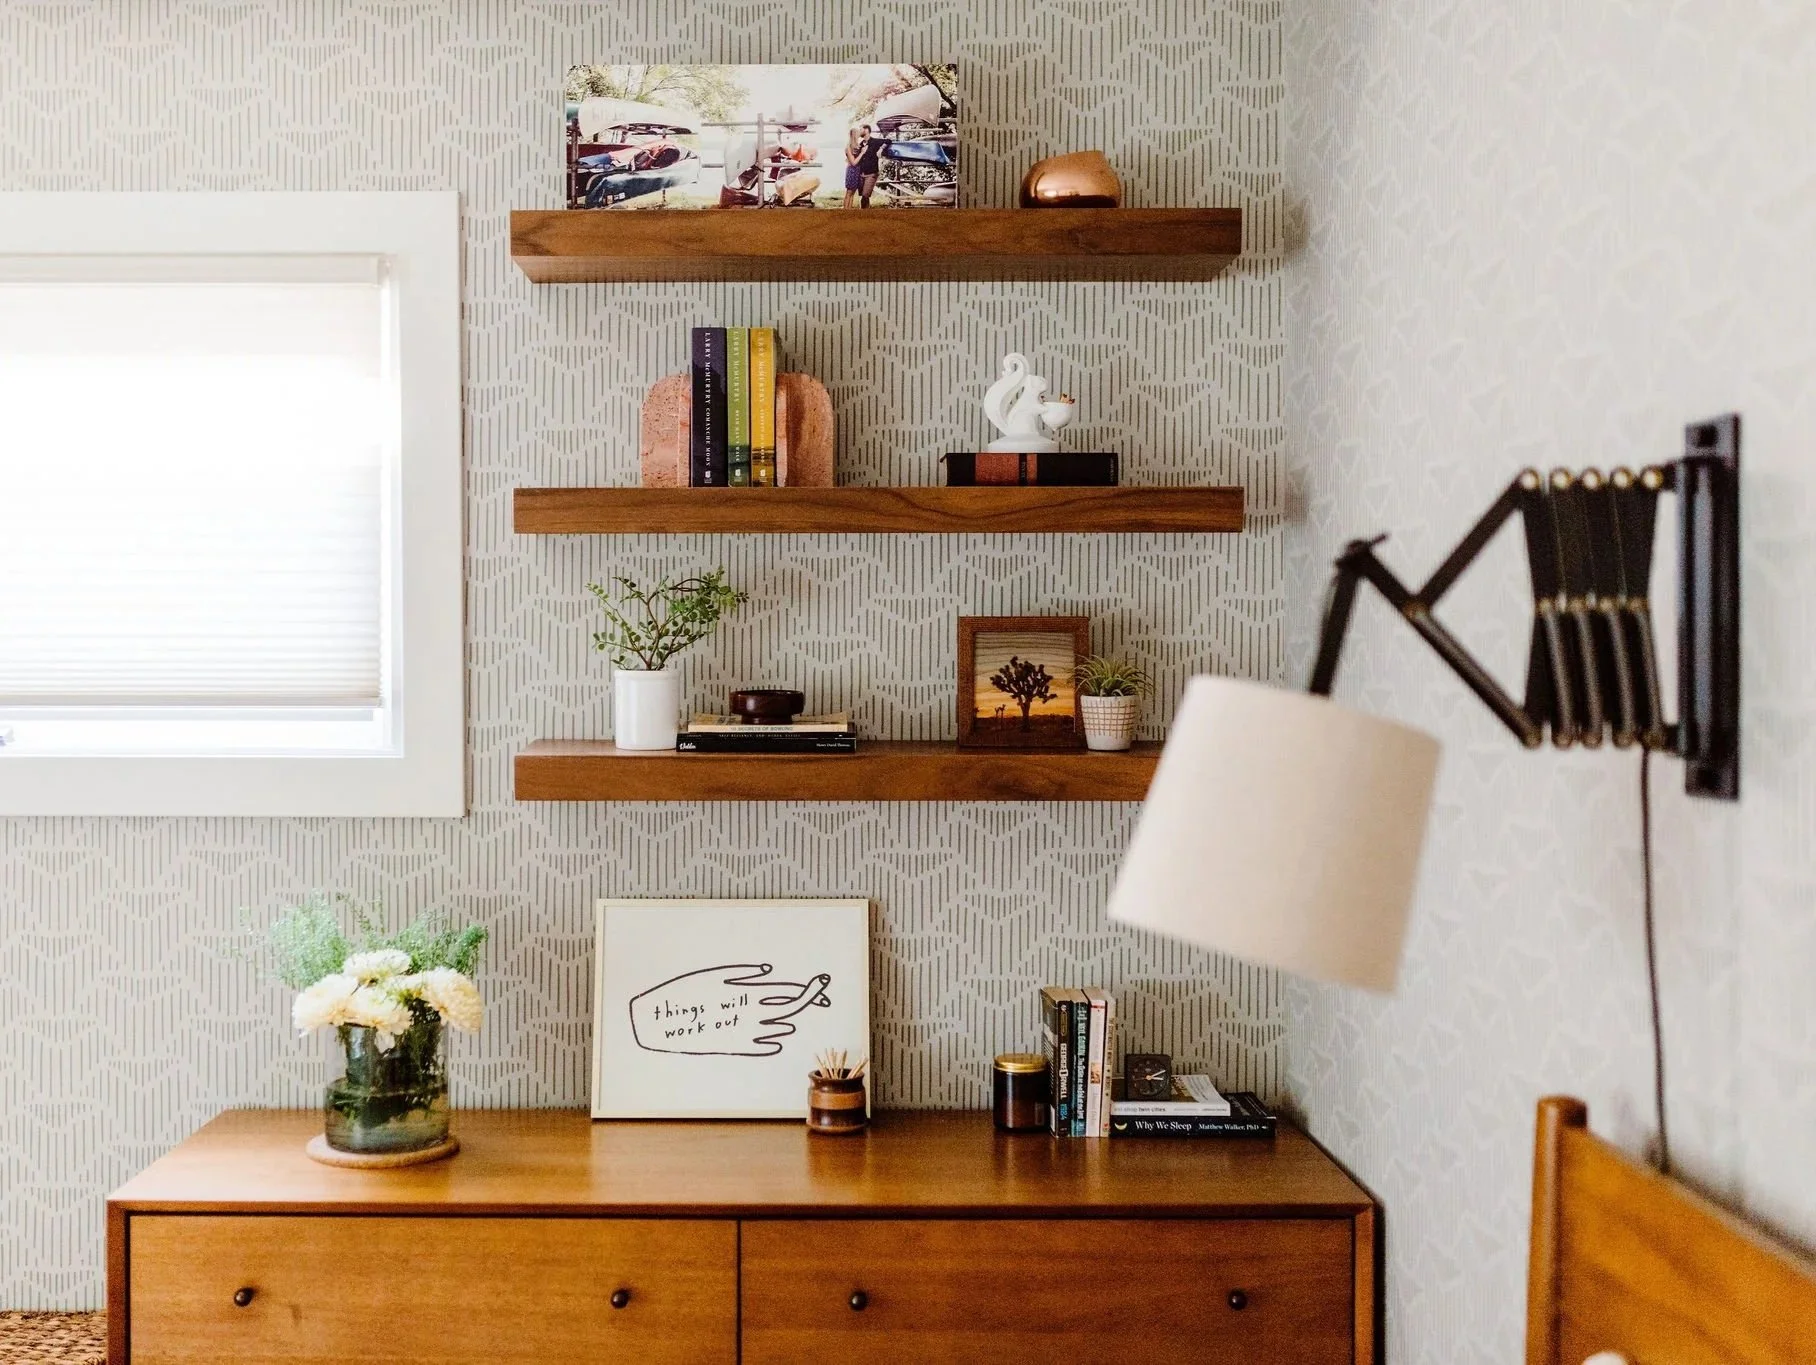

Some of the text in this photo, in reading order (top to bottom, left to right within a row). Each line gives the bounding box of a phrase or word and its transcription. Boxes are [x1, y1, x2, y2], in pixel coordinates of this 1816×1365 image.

[653, 993, 748, 1023] things will
[665, 1014, 739, 1039] work out
[1135, 1120, 1154, 1131] Why
[1155, 1121, 1169, 1129] We
[1170, 1121, 1192, 1131] Sleep
